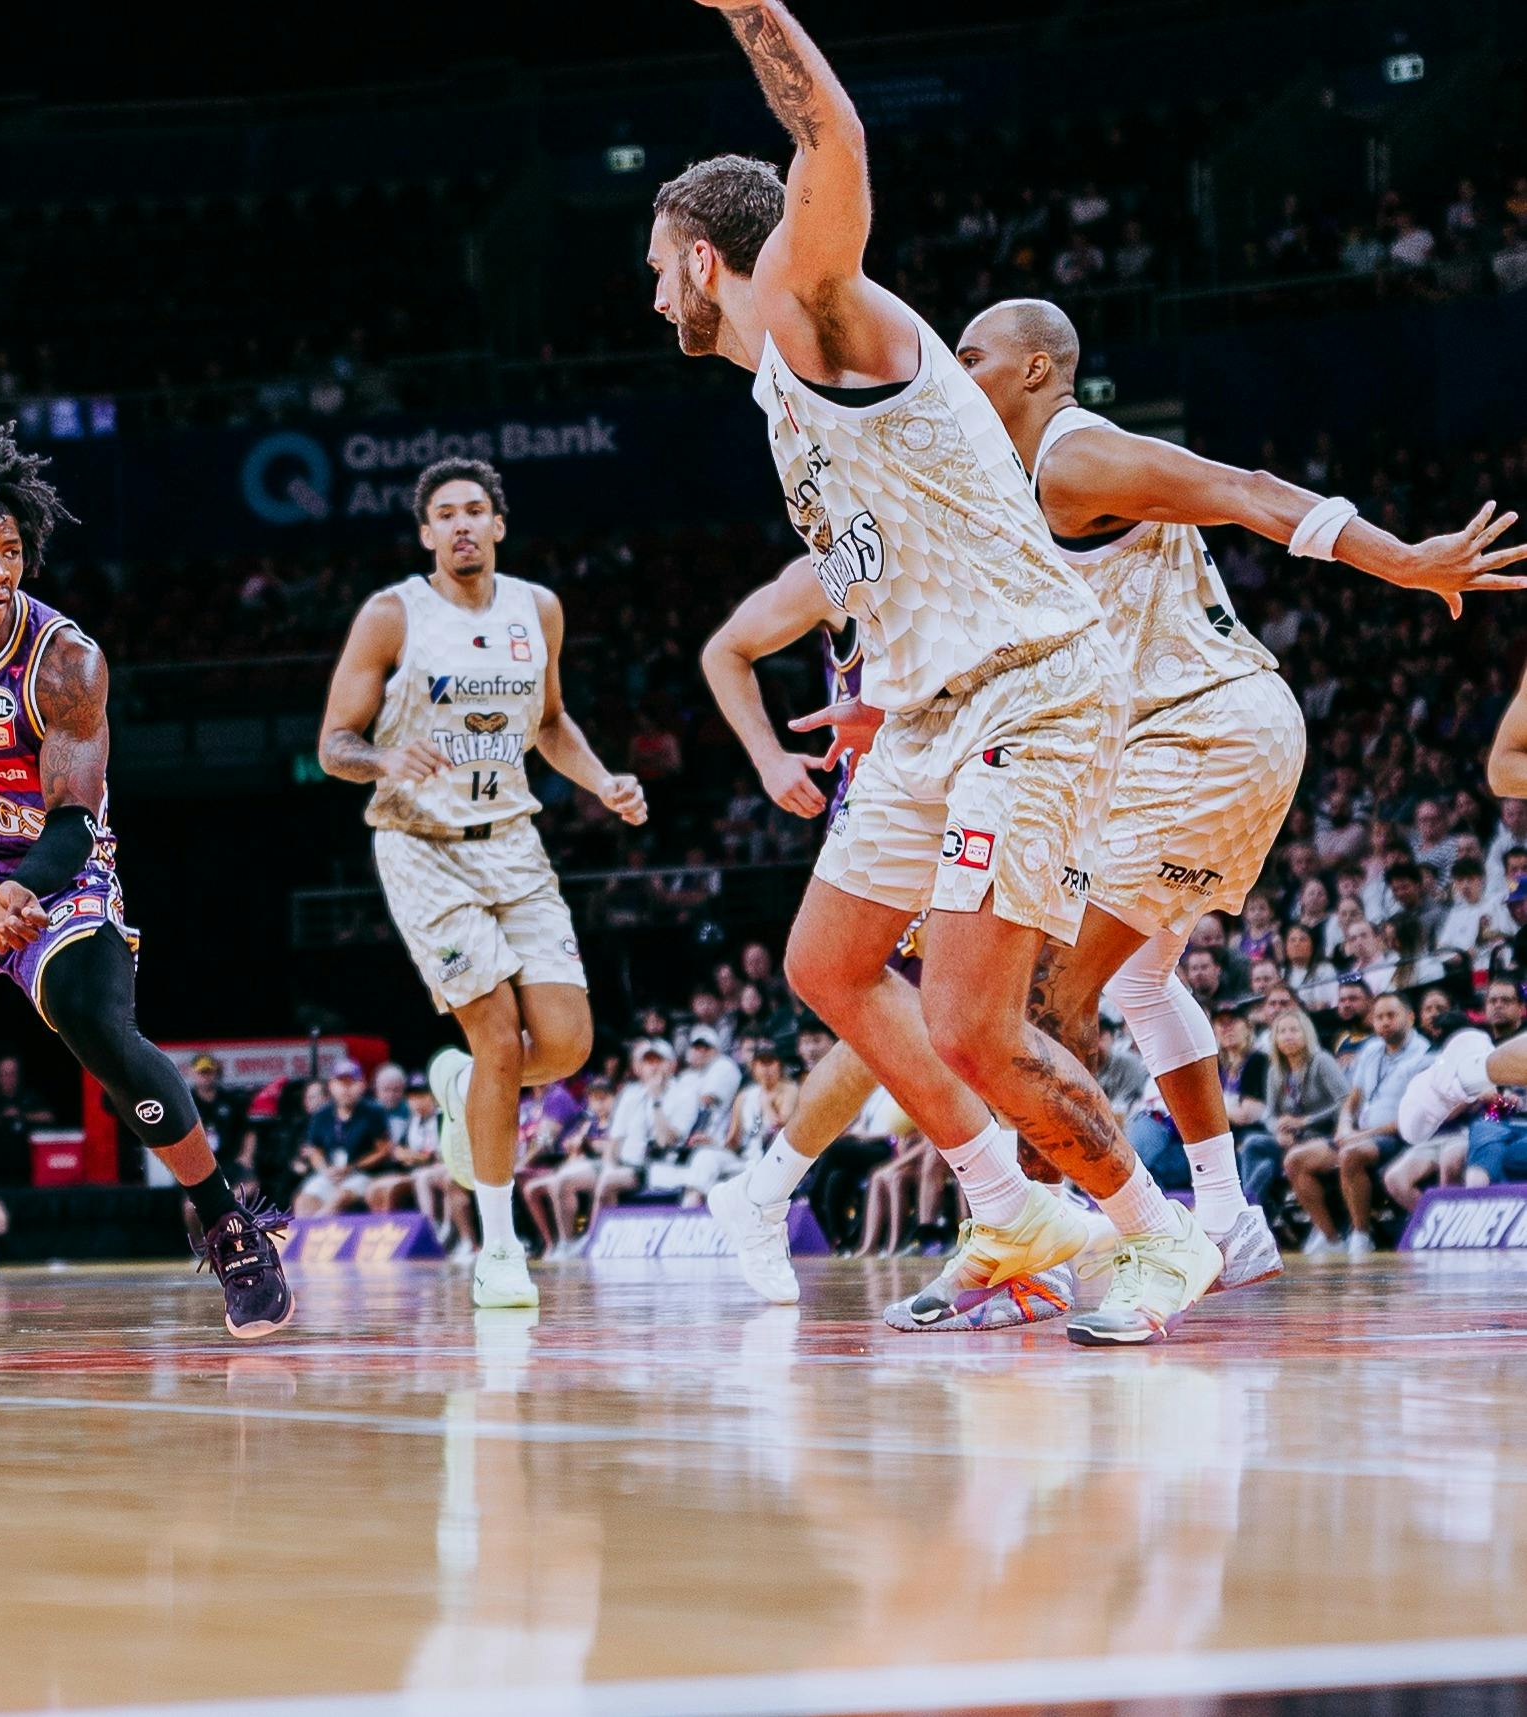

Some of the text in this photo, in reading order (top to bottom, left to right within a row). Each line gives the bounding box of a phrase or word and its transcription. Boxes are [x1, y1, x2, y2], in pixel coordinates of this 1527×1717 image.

[343, 415, 617, 470] Qudos Bank
[454, 675, 537, 695] Kenfrost
[432, 729, 524, 769] TAIPAN
[471, 770, 499, 801] 14
[1411, 1198, 1525, 1248] SYDNEY
